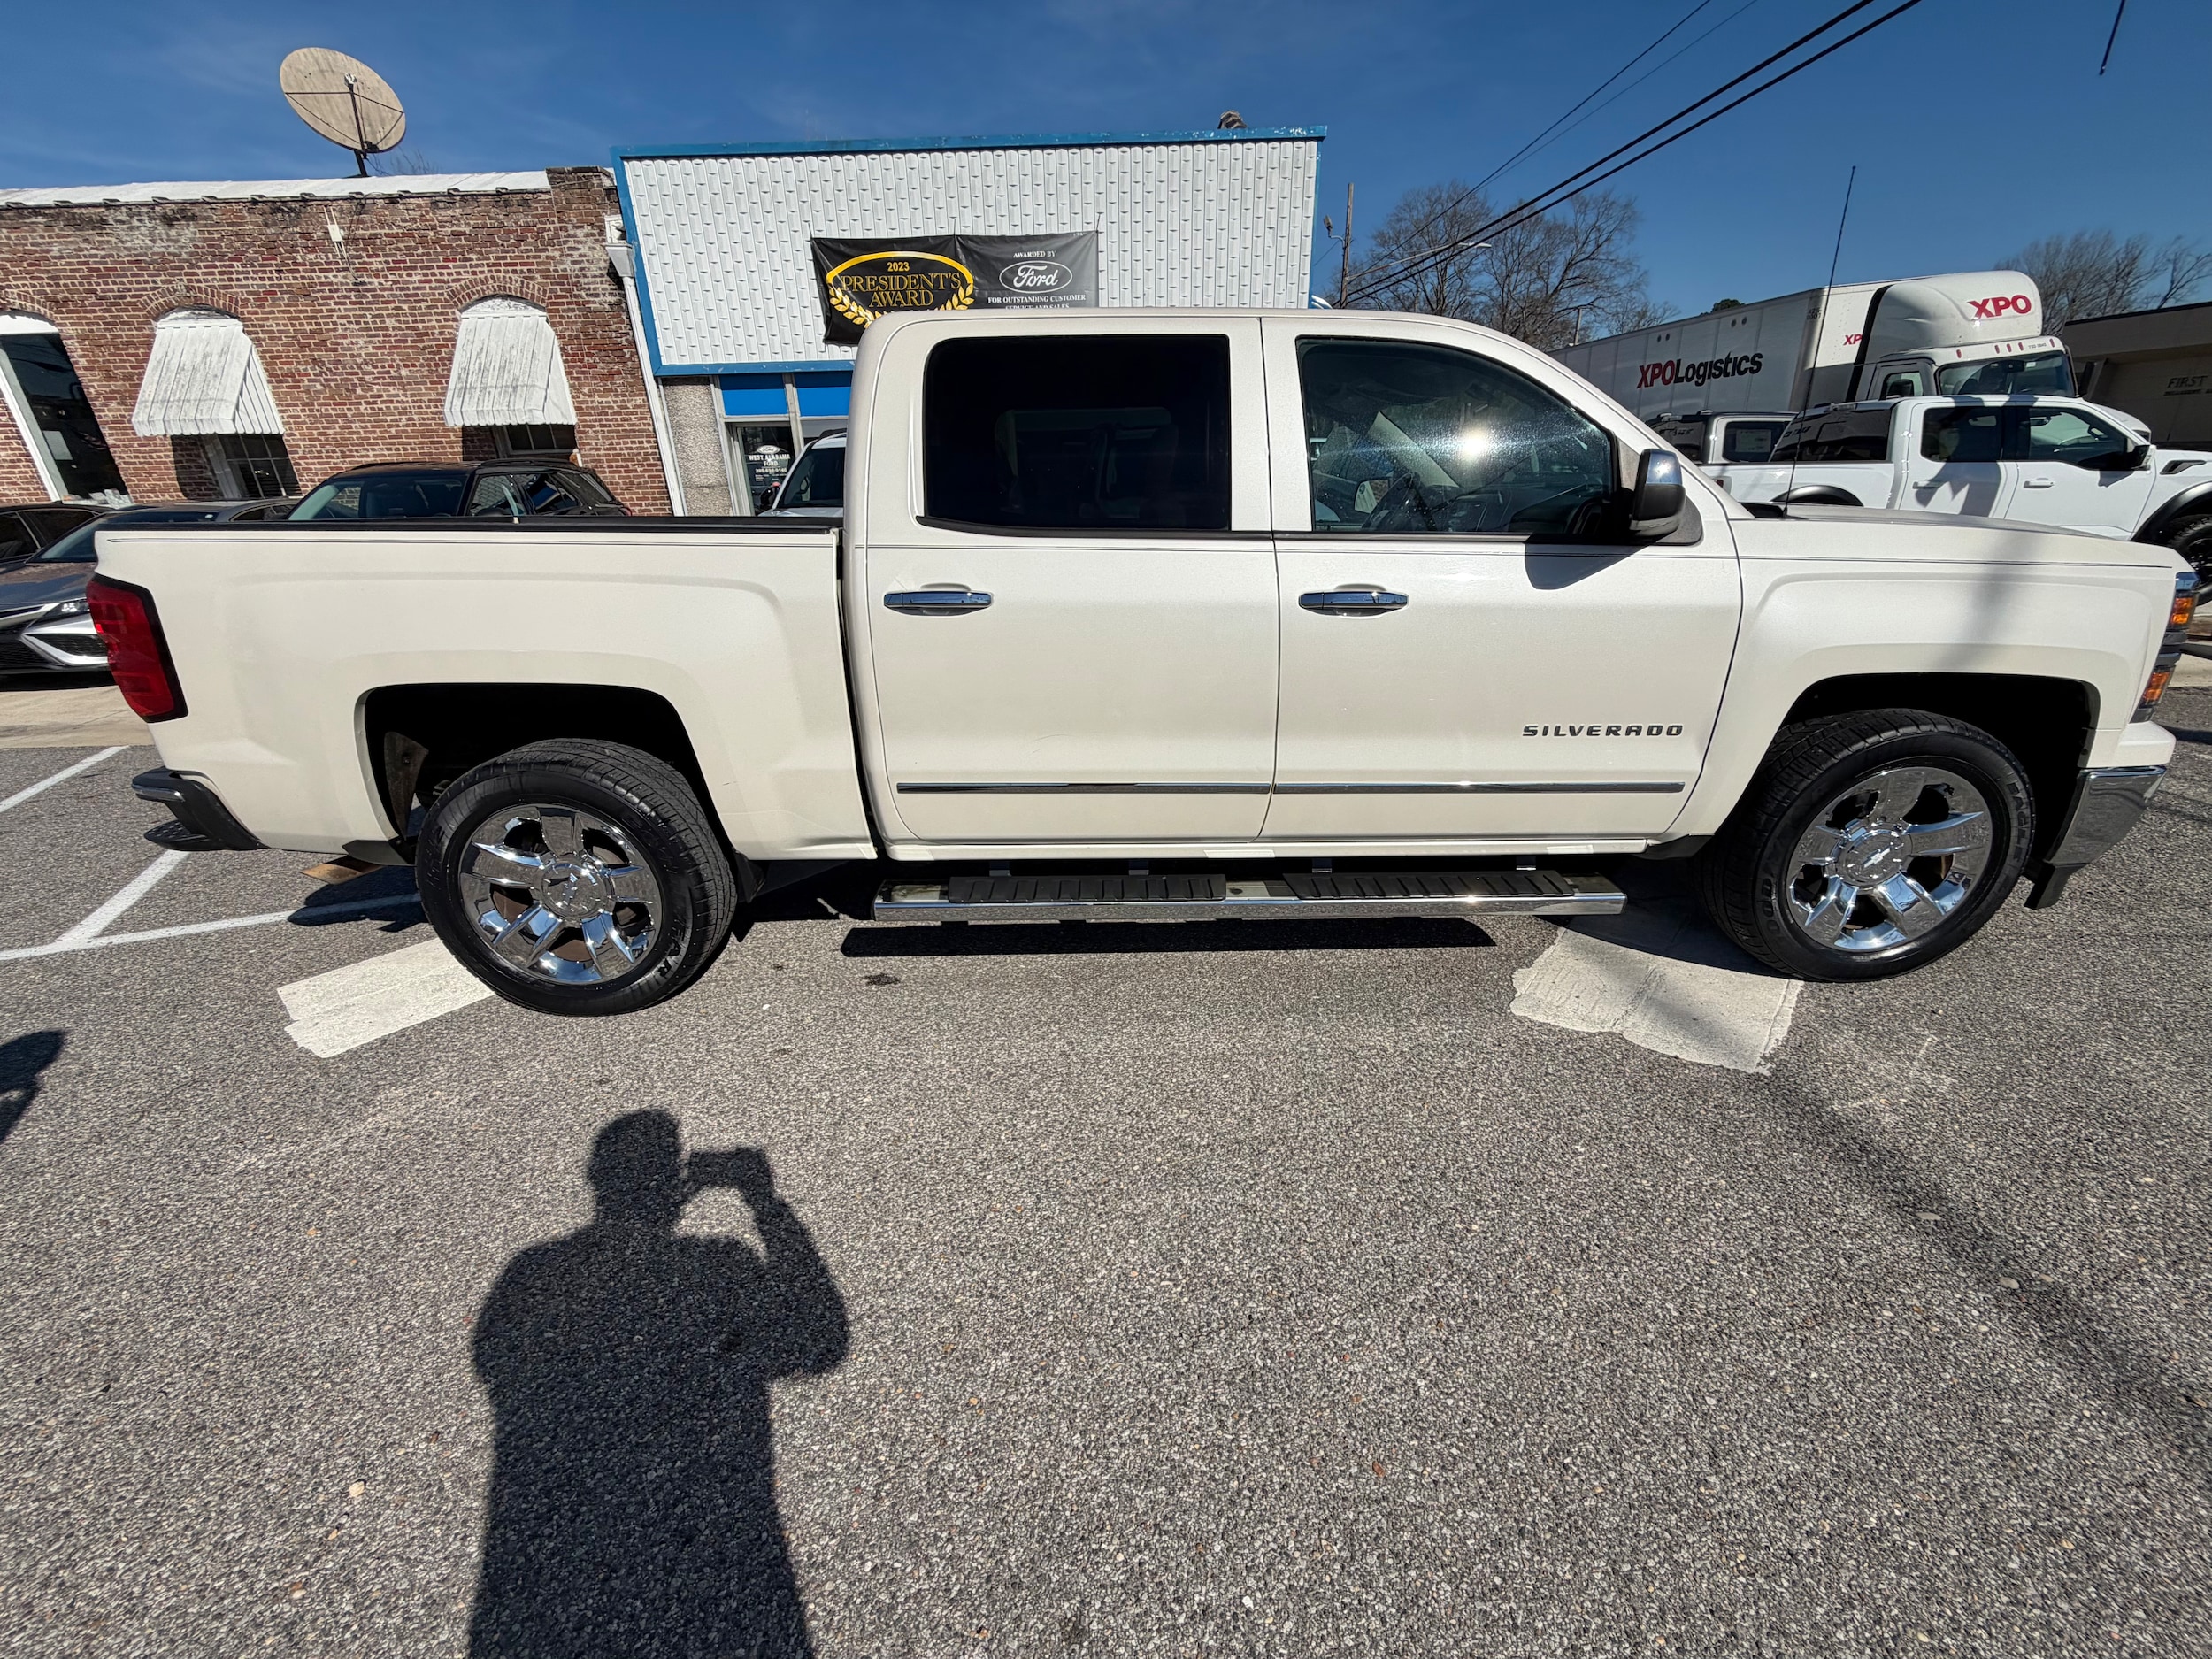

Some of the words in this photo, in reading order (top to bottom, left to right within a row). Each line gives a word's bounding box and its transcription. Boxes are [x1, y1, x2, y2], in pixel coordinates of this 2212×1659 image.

[887, 262, 910, 272] 2023
[1012, 265, 1059, 288] Ford
[841, 272, 962, 292] PRESIDENT'S
[868, 289, 934, 308] AWARD
[1967, 294, 2032, 319] XPO
[1842, 334, 1863, 346] XP
[1522, 724, 1684, 737] SILVERADO
